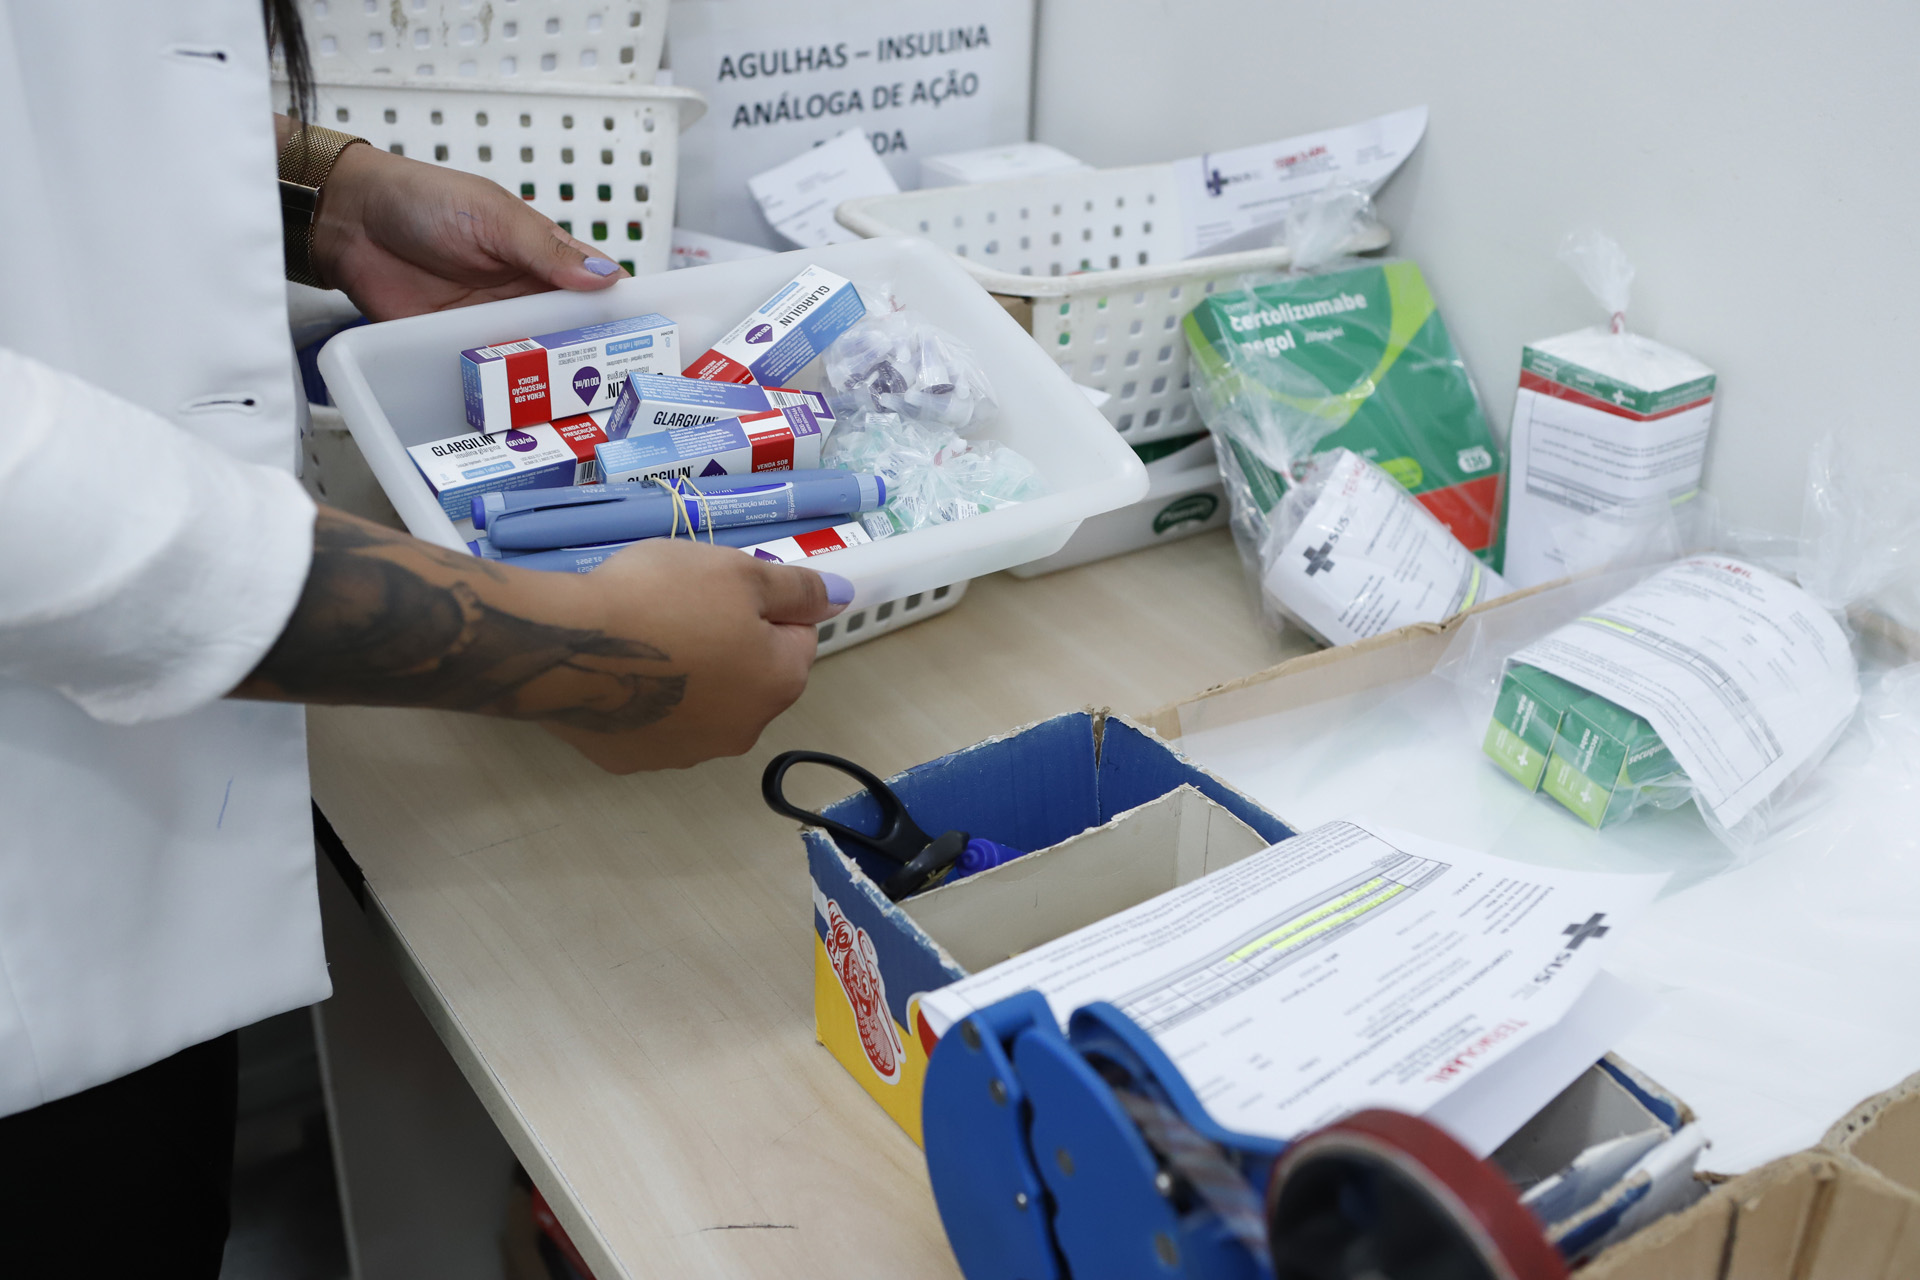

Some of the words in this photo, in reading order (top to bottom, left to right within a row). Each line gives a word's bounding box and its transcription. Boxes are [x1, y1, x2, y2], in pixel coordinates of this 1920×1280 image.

[717, 42, 848, 82] AGULHAS
[877, 24, 990, 62] INSULINA
[732, 91, 864, 128] ANÁLOGA
[872, 83, 902, 110] DE
[911, 69, 979, 109] AÇÃO
[780, 284, 831, 327] GLARGILIN
[1229, 291, 1368, 332] certolizumabe
[518, 375, 539, 384] MÉDICA
[573, 378, 589, 389] UI/mL
[590, 376, 599, 386] 100
[512, 382, 546, 395] PRESCRIÇÃO
[514, 395, 528, 404] SOB
[530, 392, 545, 402] VENDA
[609, 390, 630, 432] GLARGILIN
[563, 427, 597, 438] PRESCRIÇÃO
[574, 433, 596, 442] MÉDICA
[431, 433, 497, 457] GLARGILIN
[756, 462, 775, 470] VENDA
[776, 459, 788, 467] SOB
[729, 501, 757, 510] PRESCRIÇÃO
[758, 499, 778, 507] MÉDICA
[746, 513, 769, 521] SANOFI
[1329, 516, 1349, 542] SUS
[810, 546, 830, 556] VENDA
[1534, 951, 1572, 984] SUS
